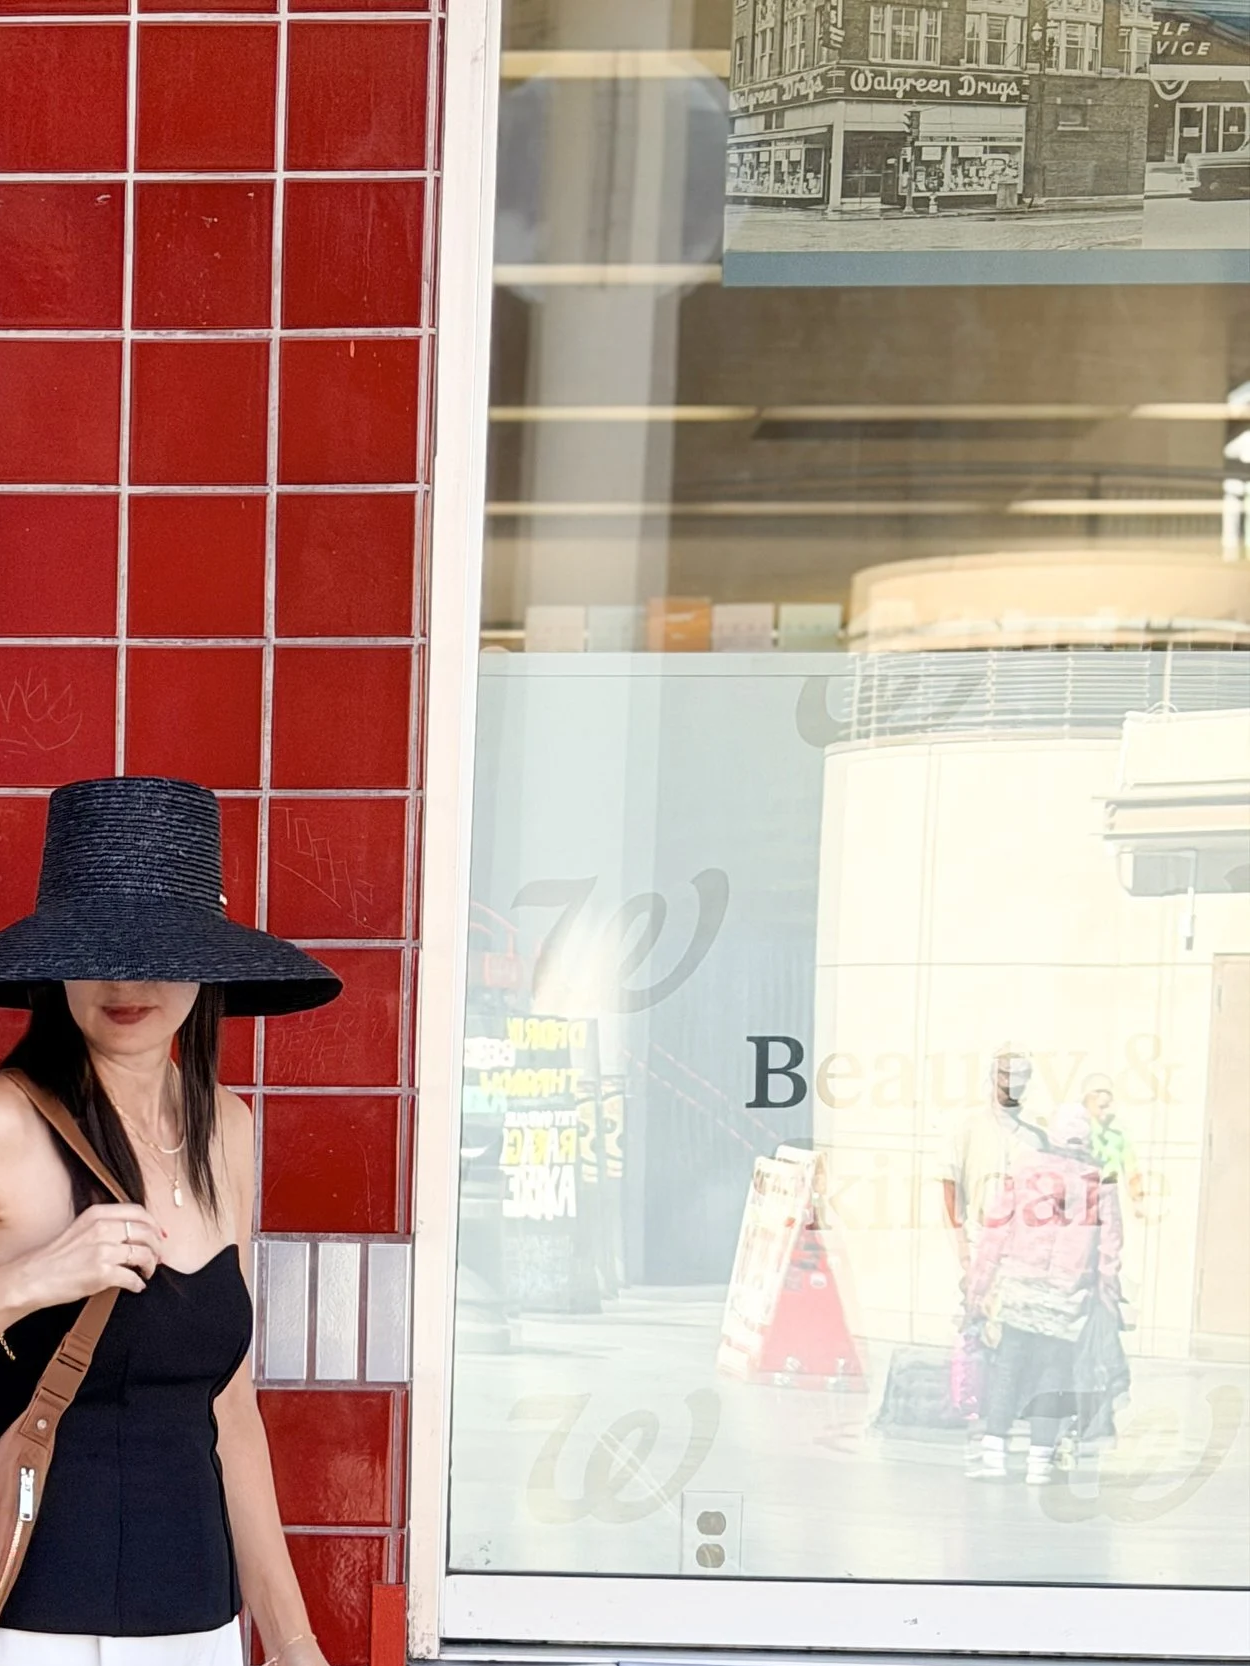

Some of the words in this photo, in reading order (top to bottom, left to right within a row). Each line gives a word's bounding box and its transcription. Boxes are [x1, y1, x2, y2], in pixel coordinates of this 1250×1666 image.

[851, 69, 950, 98] Walgreen
[958, 74, 1020, 102] Drugs
[745, 1035, 1089, 1128] Beauty
[750, 1149, 1171, 1231] kincare
